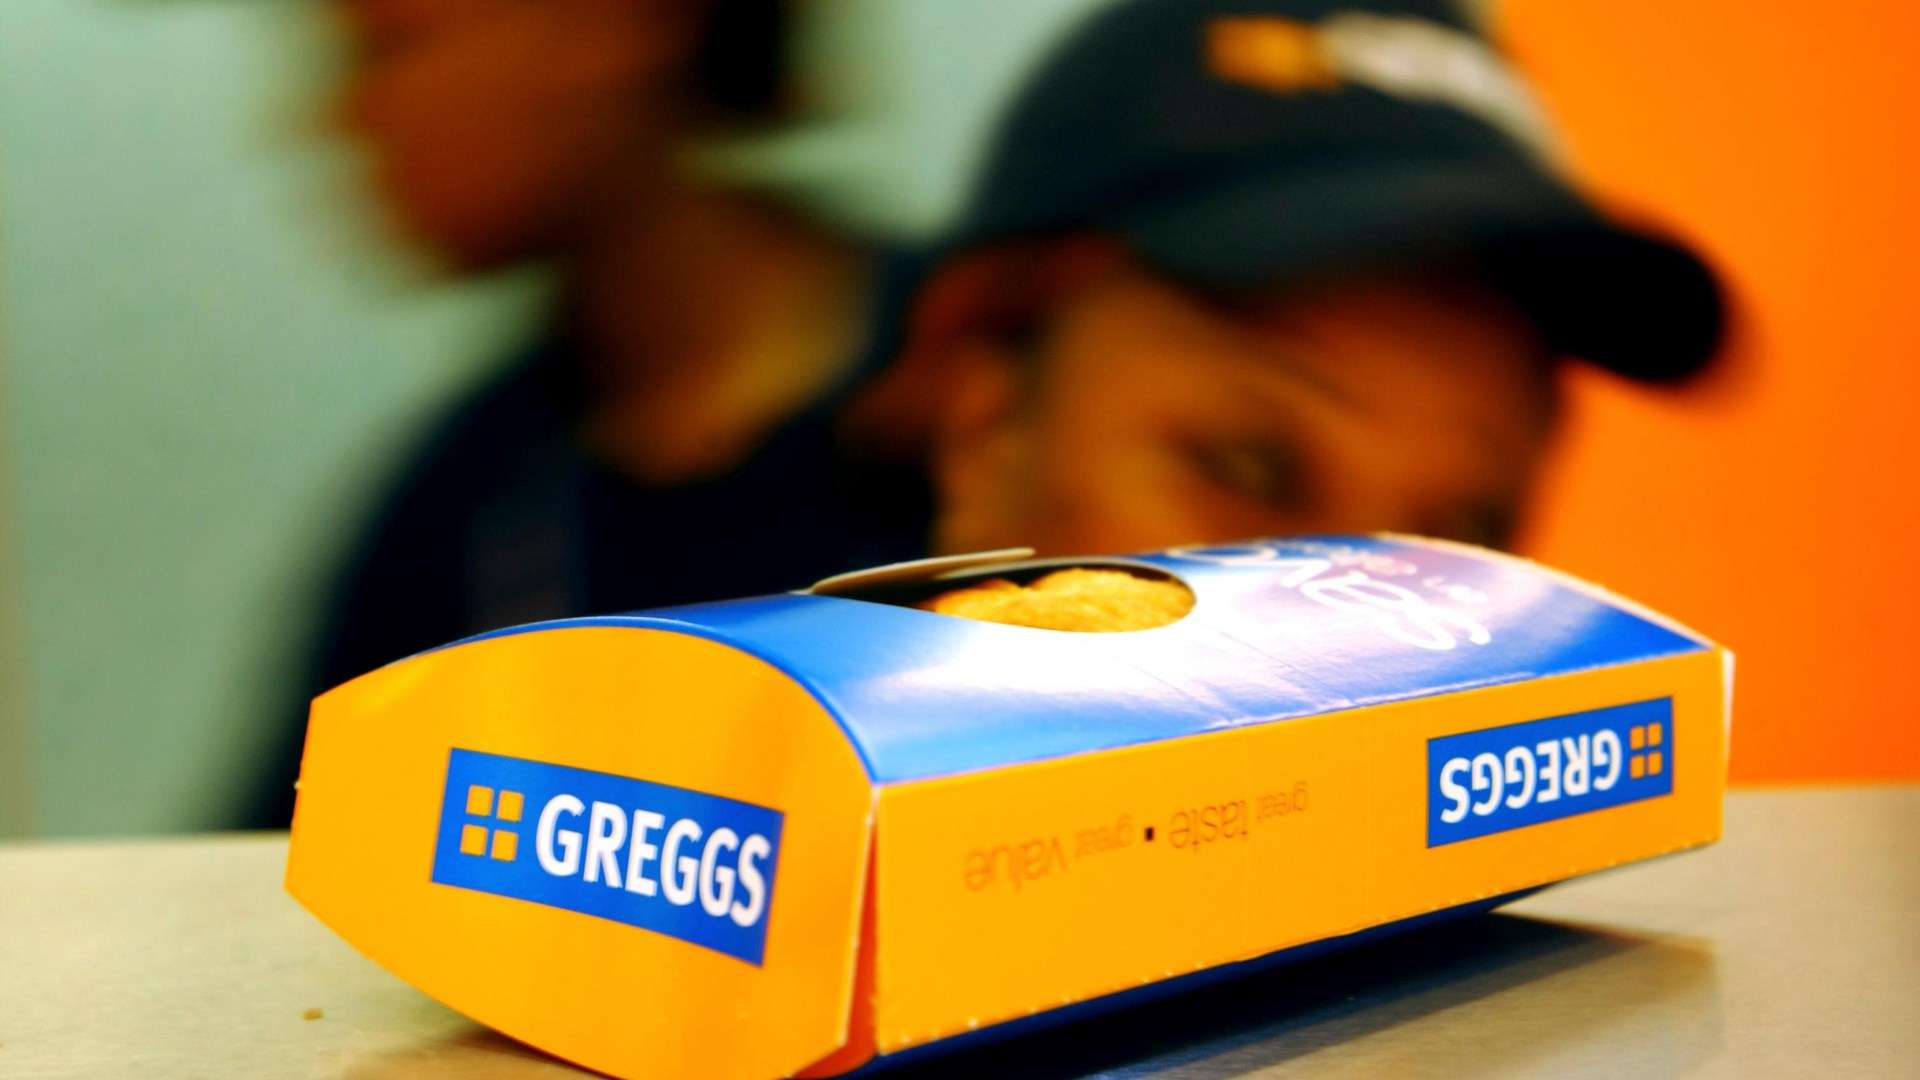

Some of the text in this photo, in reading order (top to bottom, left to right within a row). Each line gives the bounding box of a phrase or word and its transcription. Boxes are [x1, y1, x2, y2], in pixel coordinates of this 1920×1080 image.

[1439, 729, 1623, 824] GREGGS
[536, 793, 771, 927] GREGGS
[963, 780, 1307, 892] great taste great value
